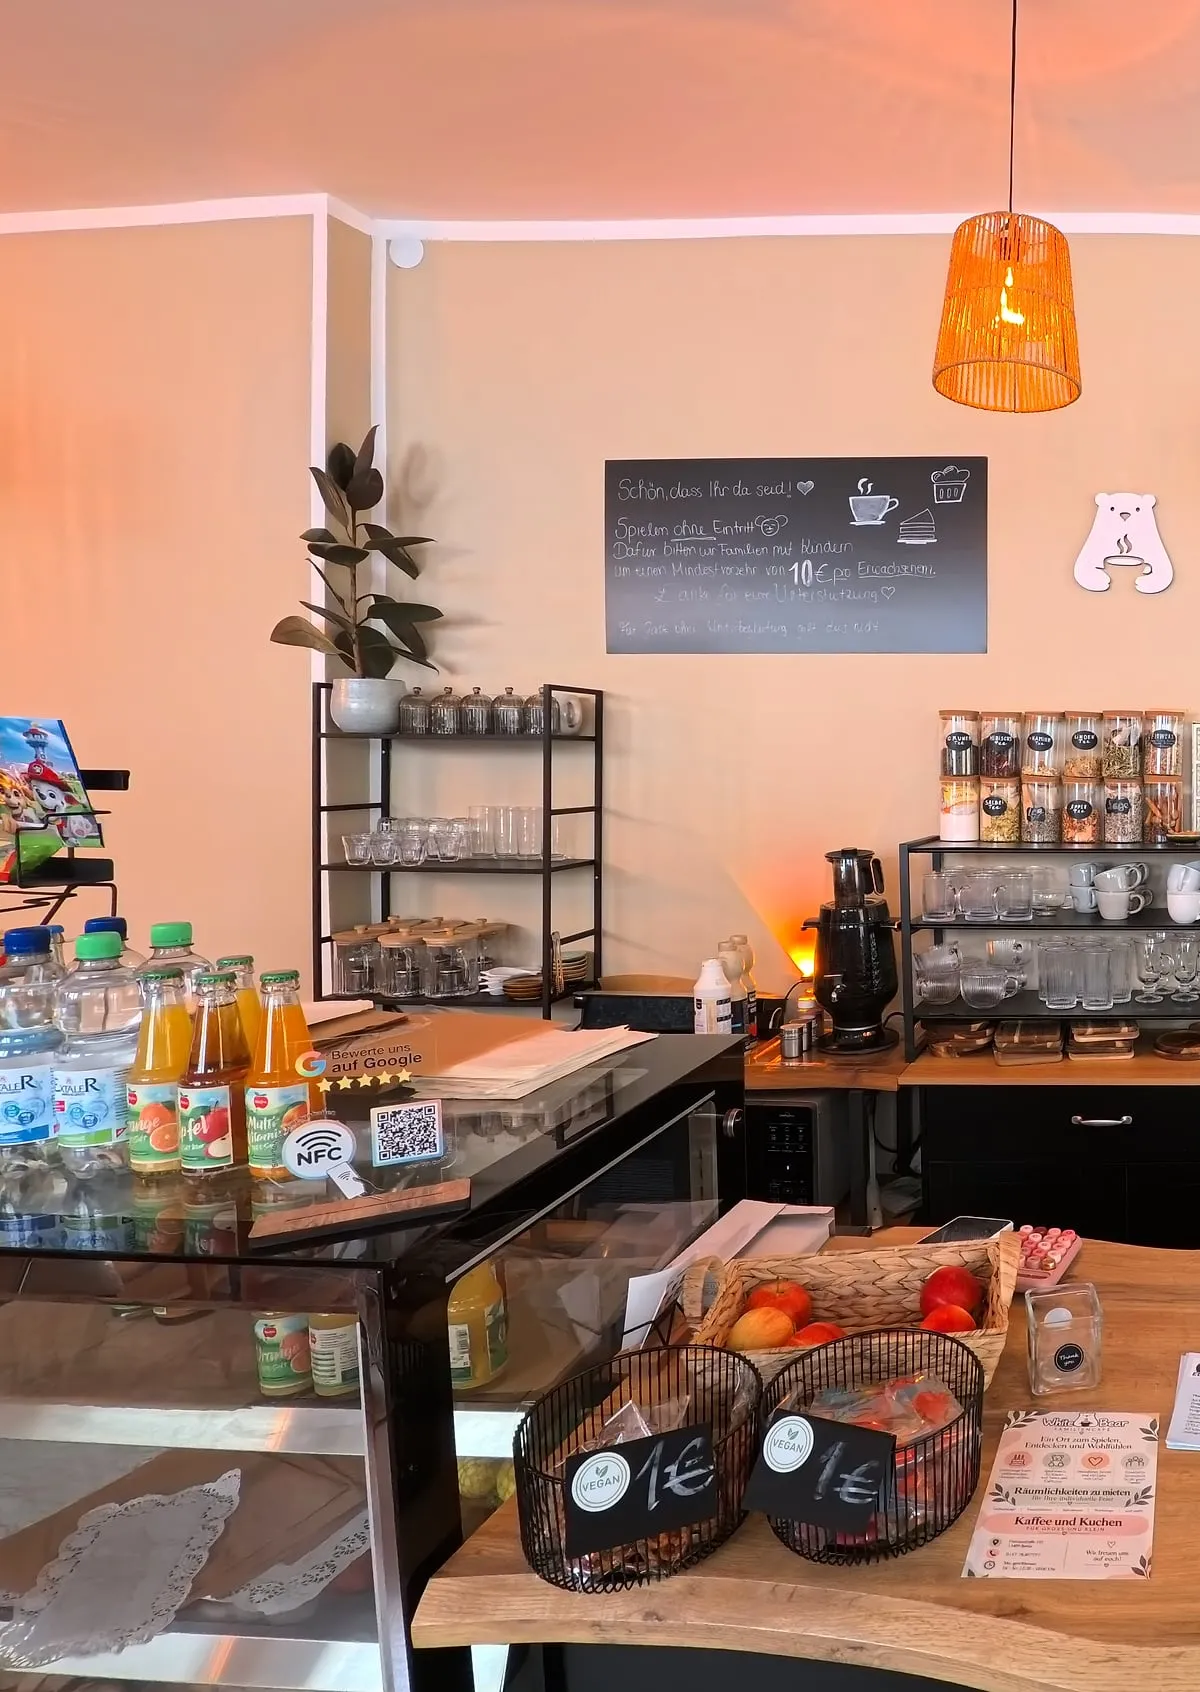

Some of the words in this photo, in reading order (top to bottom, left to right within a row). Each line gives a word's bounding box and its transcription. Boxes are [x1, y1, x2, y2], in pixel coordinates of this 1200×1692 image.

[709, 480, 730, 497] Ihr
[732, 479, 752, 497] da
[615, 517, 669, 543] Spielen
[671, 520, 716, 541] ohne
[713, 520, 754, 536] Eintritt
[664, 542, 696, 556] bitten
[718, 543, 768, 556] Familien
[773, 541, 792, 557] mit
[766, 565, 786, 576] von
[331, 1047, 384, 1060] Bewerte
[389, 1044, 411, 1054] uns
[332, 1060, 357, 1073] auf
[363, 1053, 422, 1069] Google
[296, 1147, 342, 1166] NFC
[1043, 1417, 1075, 1427] White
[1098, 1418, 1130, 1427] Bear
[773, 1439, 804, 1453] VEGAN
[582, 1475, 621, 1492] VEGAN
[1014, 1487, 1088, 1496] Räumlichkeiten
[1102, 1488, 1131, 1496] mieten
[1014, 1516, 1053, 1526] Kaffee
[1054, 1517, 1077, 1526] und
[1080, 1518, 1123, 1527] Kuchen
